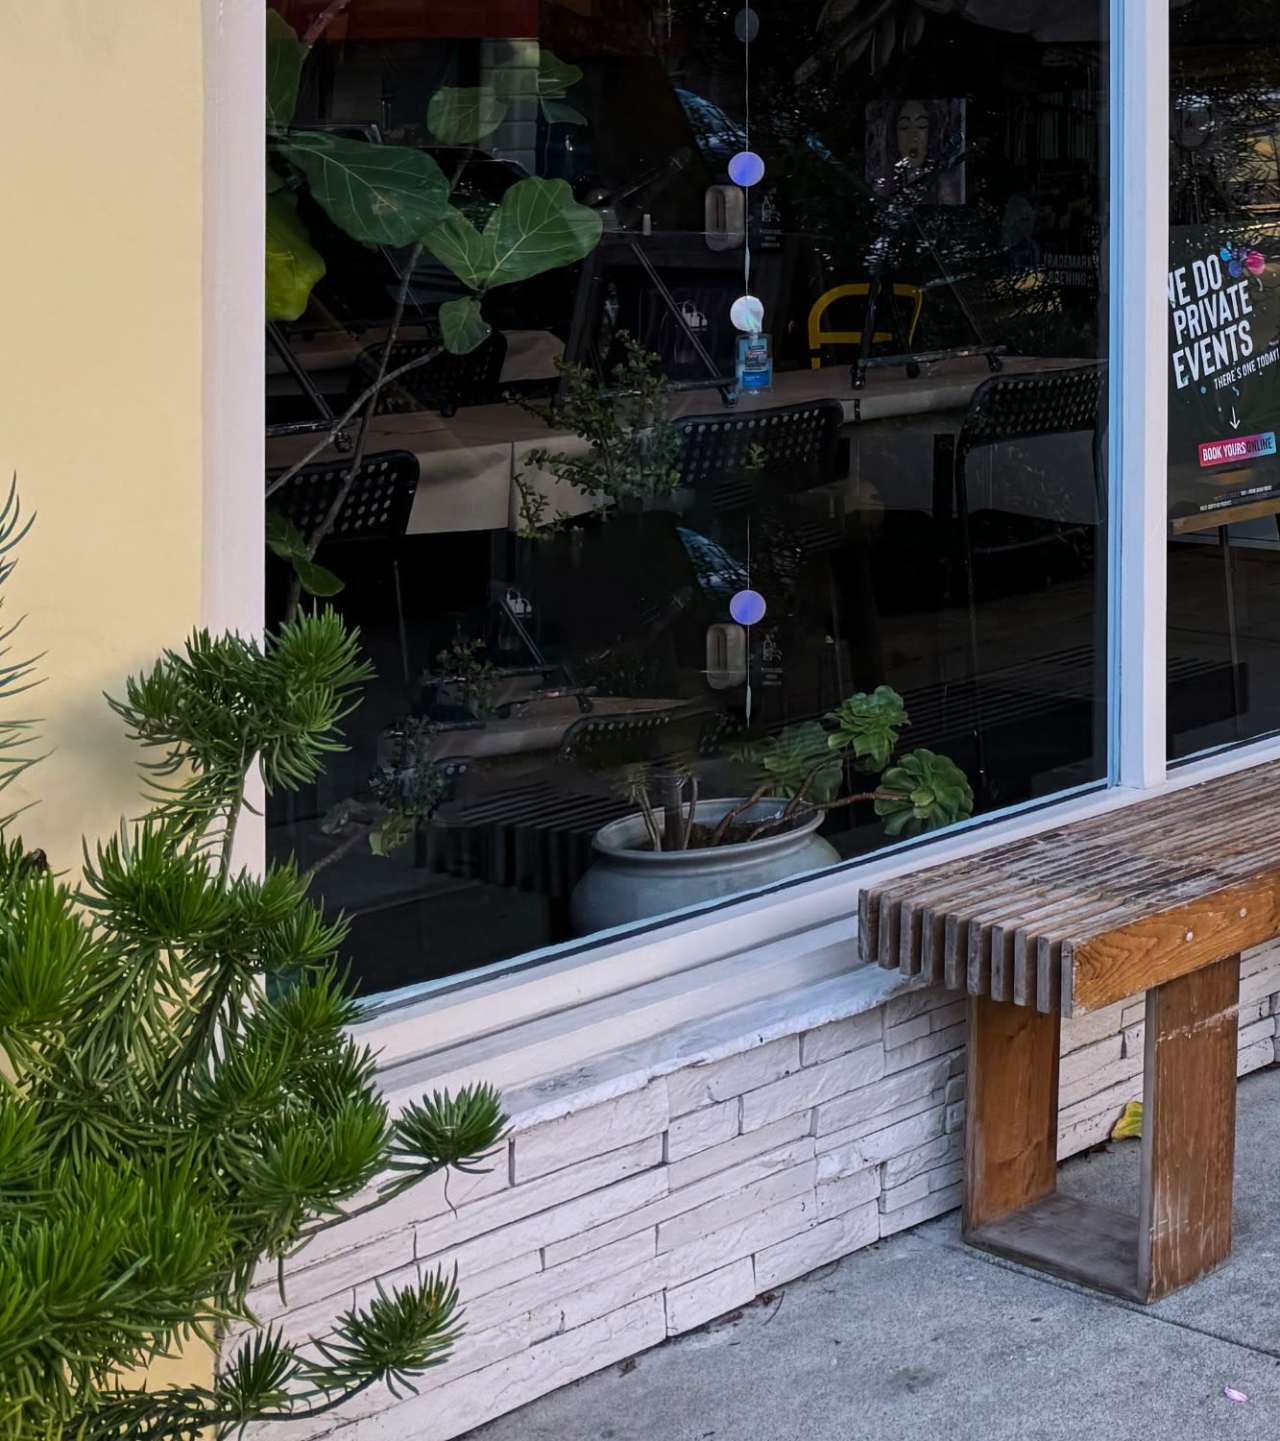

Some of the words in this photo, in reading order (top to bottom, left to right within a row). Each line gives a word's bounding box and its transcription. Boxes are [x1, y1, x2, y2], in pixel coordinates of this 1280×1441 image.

[1192, 254, 1222, 298] DO
[1173, 280, 1253, 345] PRIVATE
[1172, 319, 1253, 389] EVENTS
[1214, 366, 1242, 390] THERE'S
[1242, 360, 1257, 376] ONE
[1257, 348, 1280, 369] TODAY!
[1203, 446, 1222, 461] BOOK
[1223, 441, 1247, 457] YOURS
